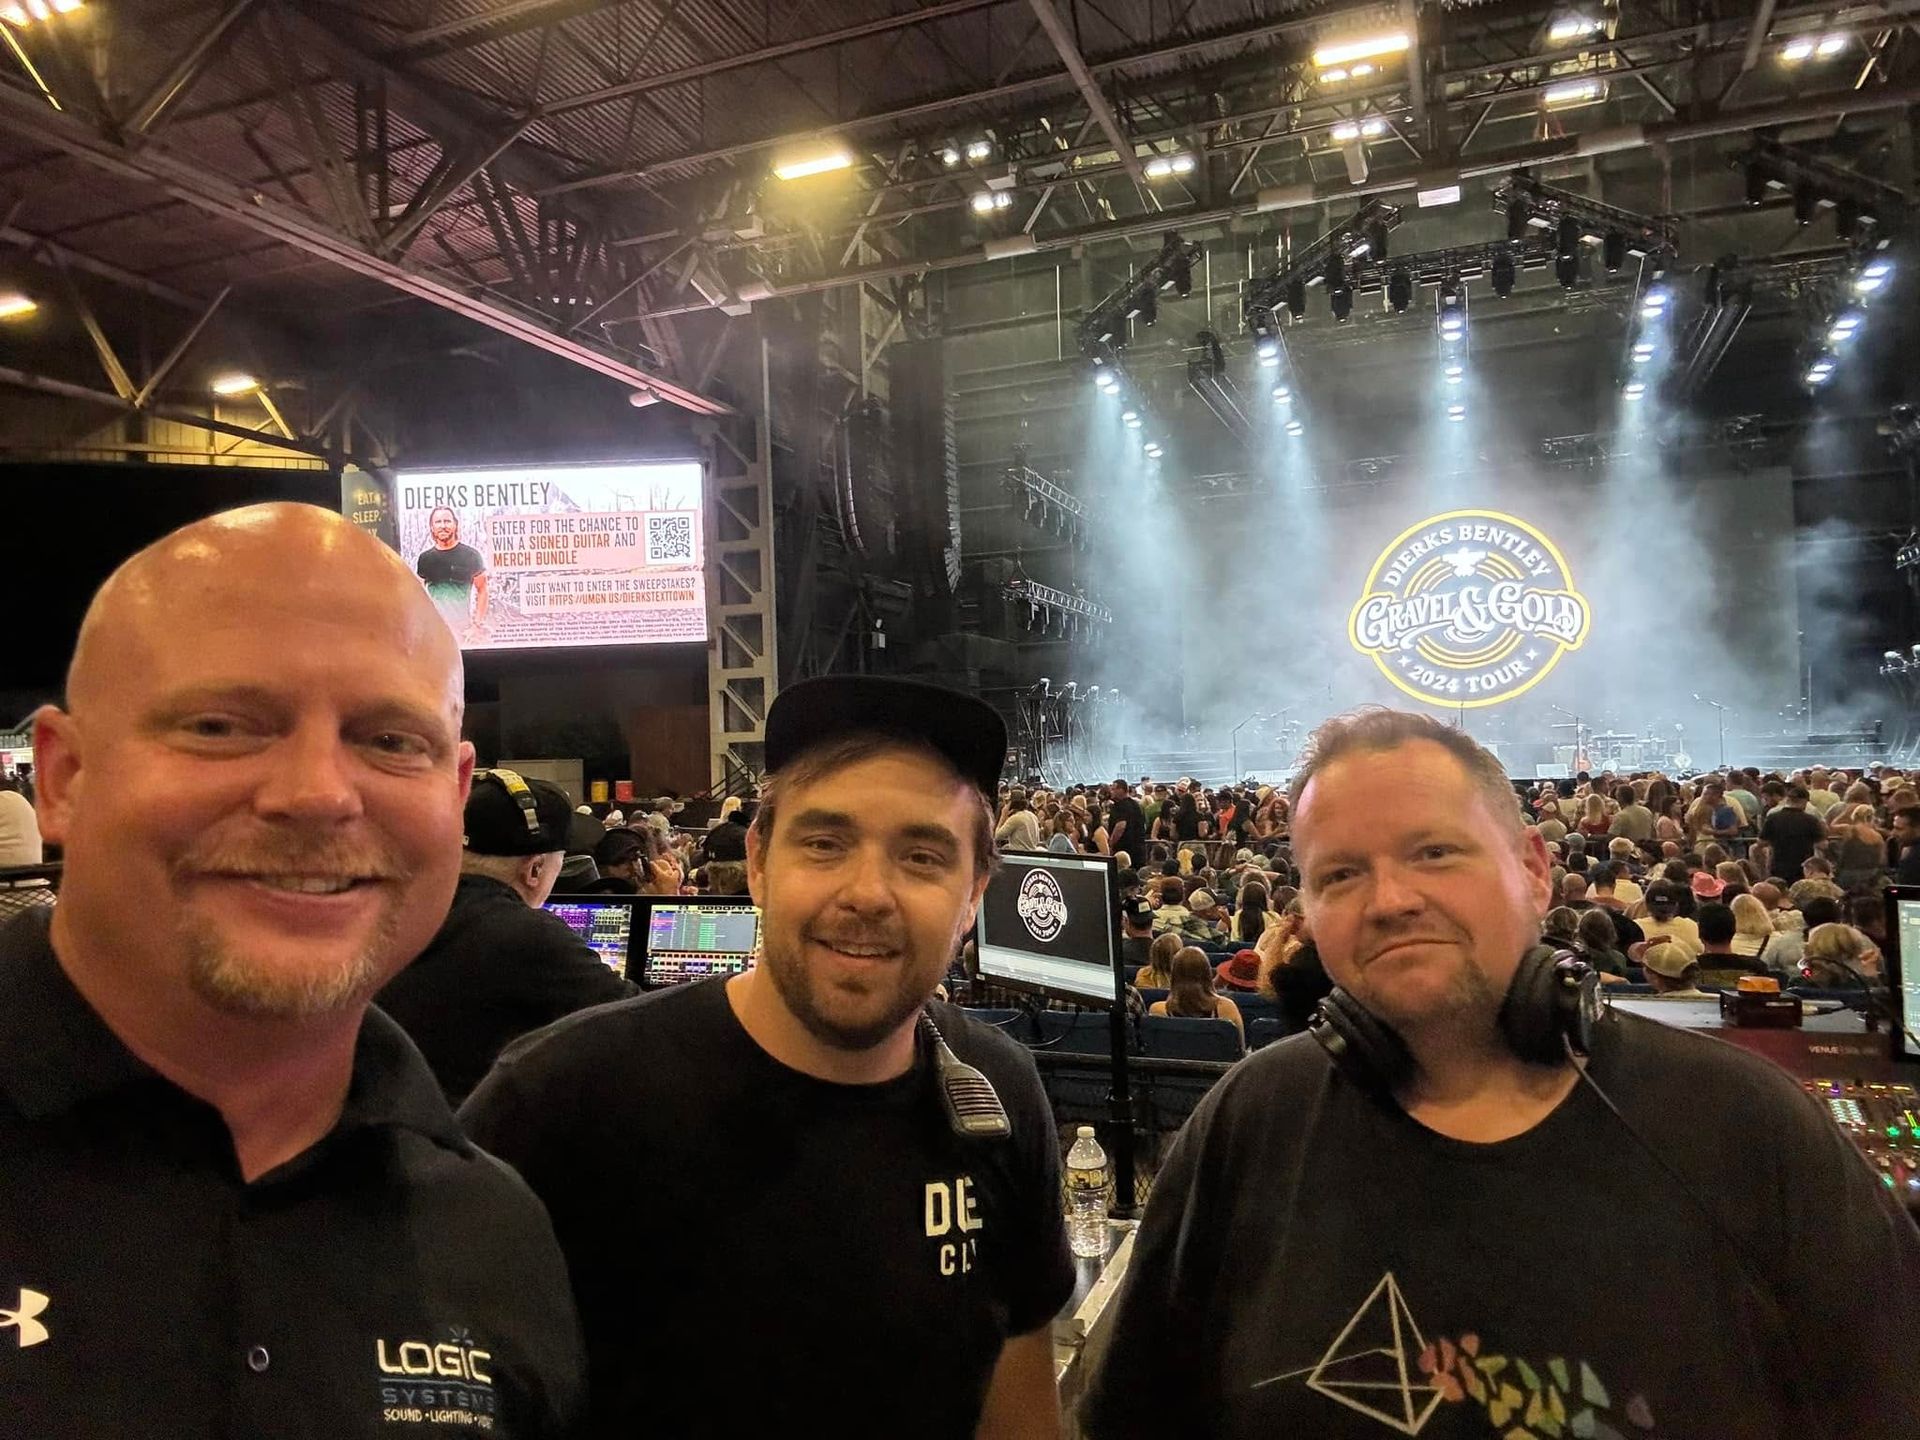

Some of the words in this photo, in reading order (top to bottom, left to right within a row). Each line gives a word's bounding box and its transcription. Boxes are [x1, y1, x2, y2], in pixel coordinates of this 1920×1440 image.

[404, 485, 468, 510] DIERKS
[474, 482, 550, 507] BENTLEY
[492, 520, 526, 535] ENTER
[530, 519, 550, 534] FOR
[555, 518, 575, 533] THE
[579, 516, 621, 532] CHANCE
[625, 516, 639, 531] TO
[492, 537, 514, 551] WIN
[518, 537, 526, 550] A
[529, 535, 569, 550] SIGNED
[573, 533, 610, 549] GUITAR
[614, 532, 636, 547] AND
[493, 552, 531, 567] MERCH
[536, 550, 578, 565] BUNDLE
[1383, 527, 1454, 587] DIERKS
[1458, 525, 1551, 576] BENTLEY
[525, 582, 545, 594] JUST
[549, 581, 571, 593] WANT
[574, 581, 584, 592] TO
[587, 580, 612, 592] ENTER
[616, 579, 630, 591] THE
[633, 577, 696, 590] SWEEPSTAKES?
[525, 595, 546, 606] VISIT
[1356, 591, 1455, 650] GRAVEL
[1451, 586, 1495, 634] &
[1488, 581, 1583, 643] GOLD
[1408, 665, 1460, 693] 2024
[1464, 660, 1531, 693] TOUR
[1808, 1045, 1839, 1055] VENUE
[376, 1338, 492, 1385] LOGIC
[383, 1408, 423, 1422] SOUND
[430, 1409, 473, 1424] LIGHTING
